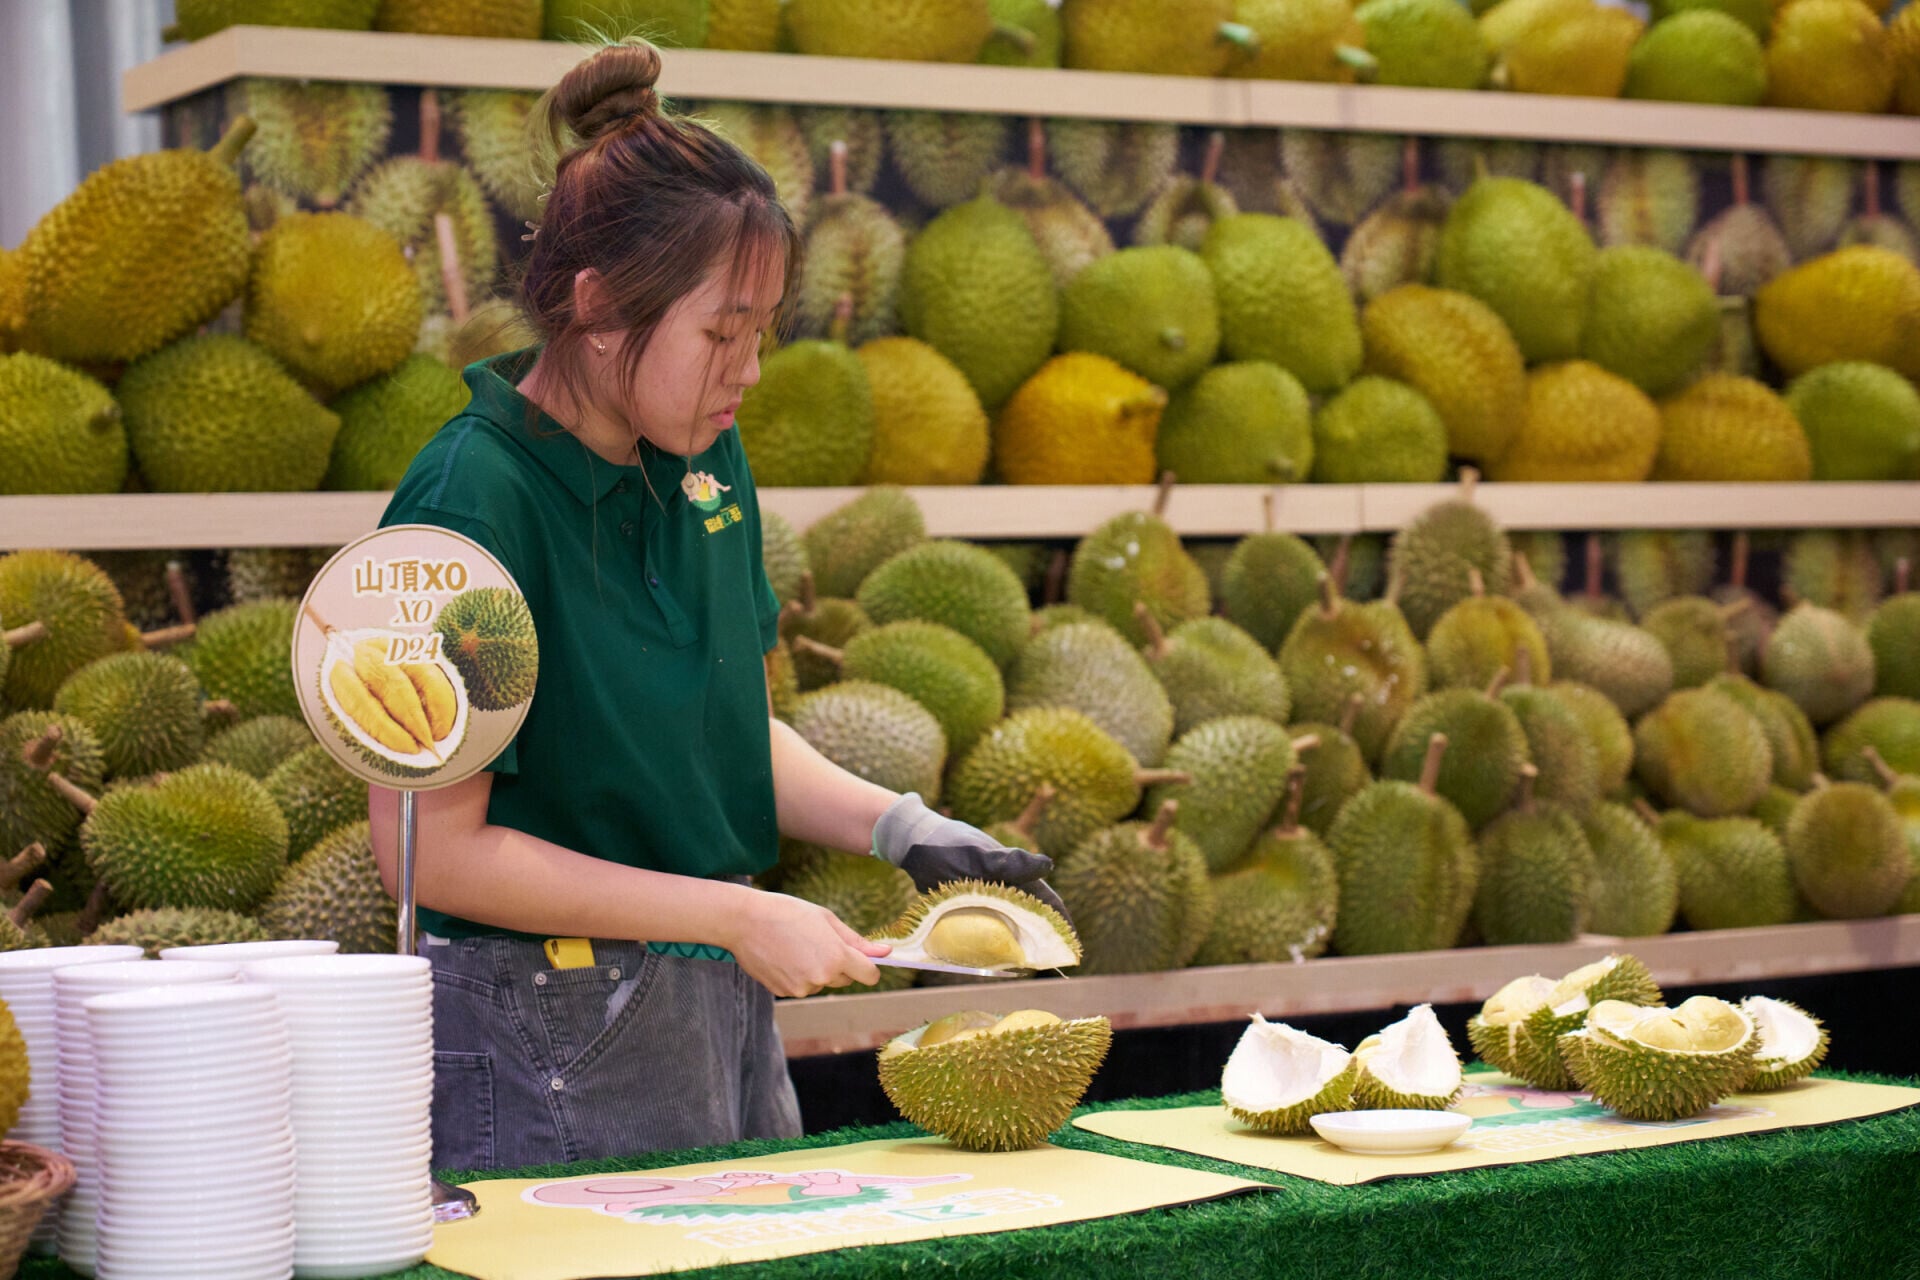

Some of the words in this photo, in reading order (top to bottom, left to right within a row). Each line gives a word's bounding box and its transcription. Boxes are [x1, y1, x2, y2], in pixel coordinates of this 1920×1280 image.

[355, 559, 468, 593] 山頂XO
[394, 599, 433, 624] XO
[388, 636, 440, 662] D24
